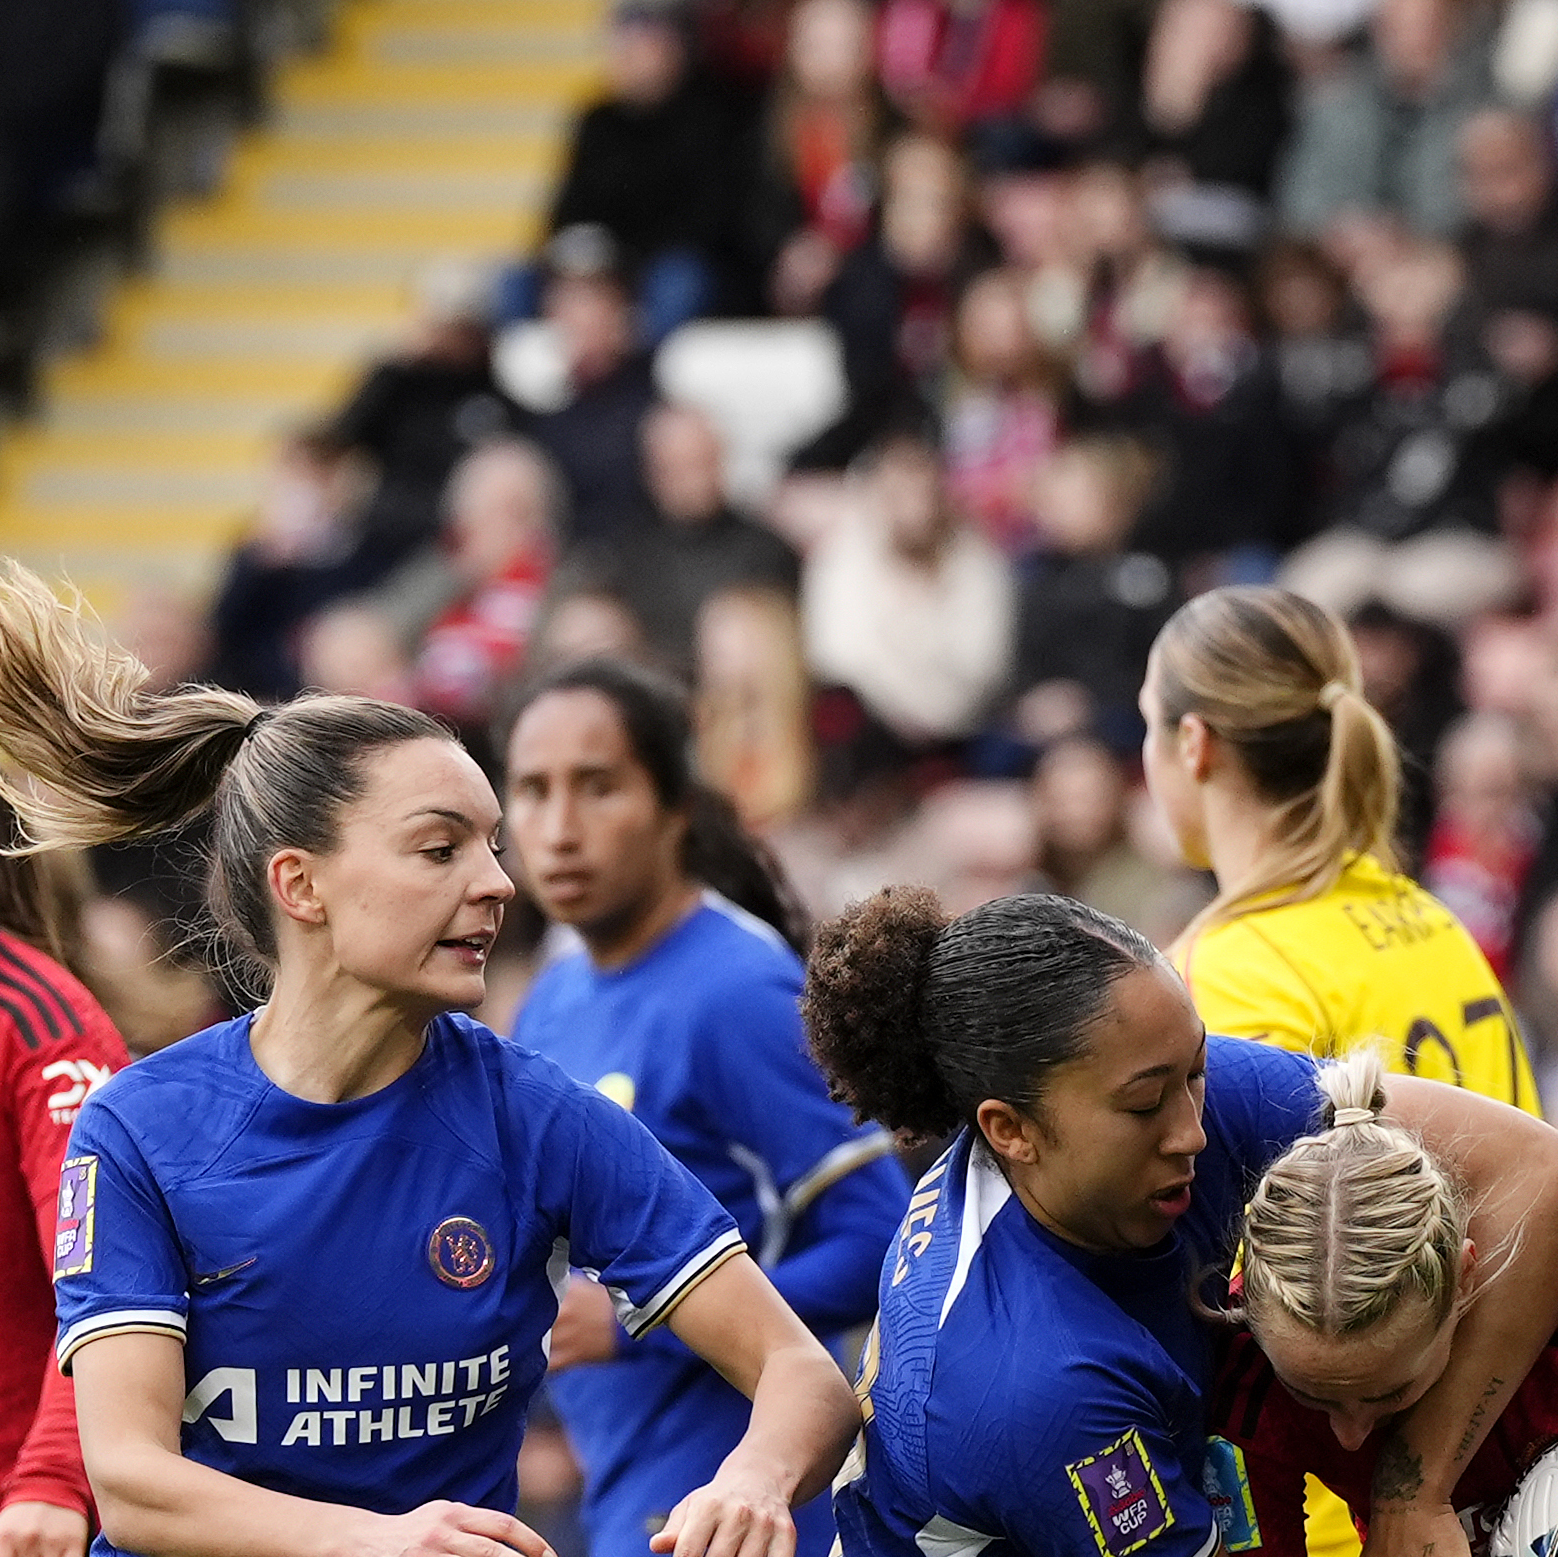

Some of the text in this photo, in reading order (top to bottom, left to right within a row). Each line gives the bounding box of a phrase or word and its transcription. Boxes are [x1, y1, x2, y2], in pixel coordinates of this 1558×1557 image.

[286, 1344, 511, 1403] INFINITE
[280, 1384, 508, 1447] ATHLETE
[1112, 1499, 1147, 1527] WFA
[1120, 1511, 1147, 1535] CUP
